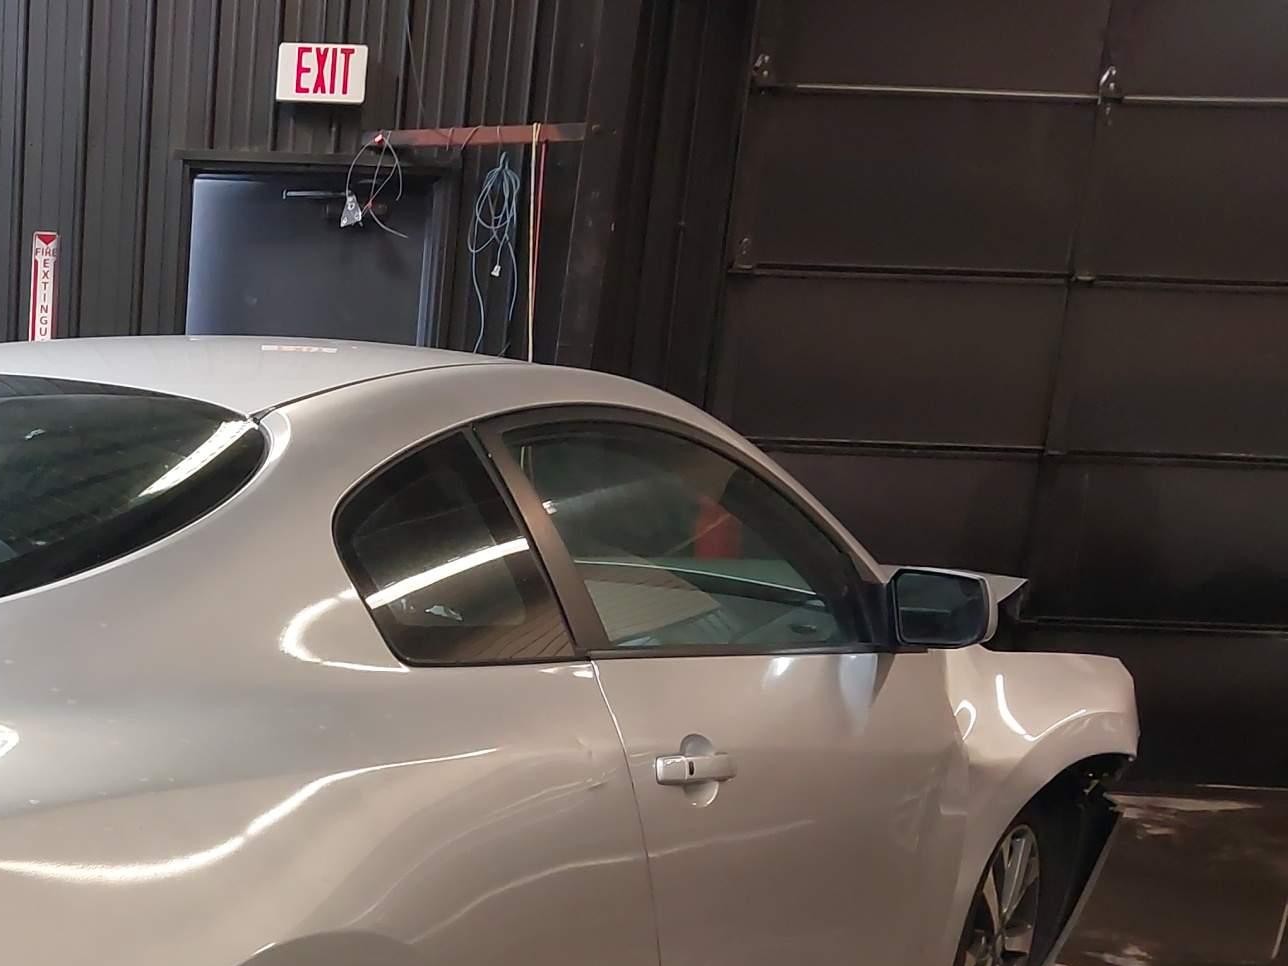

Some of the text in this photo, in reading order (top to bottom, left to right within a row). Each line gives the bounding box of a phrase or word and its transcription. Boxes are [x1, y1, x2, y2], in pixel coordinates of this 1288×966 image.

[295, 47, 355, 95] EXIT
[35, 247, 56, 257] FIRE
[39, 258, 50, 340] EXTINGU
